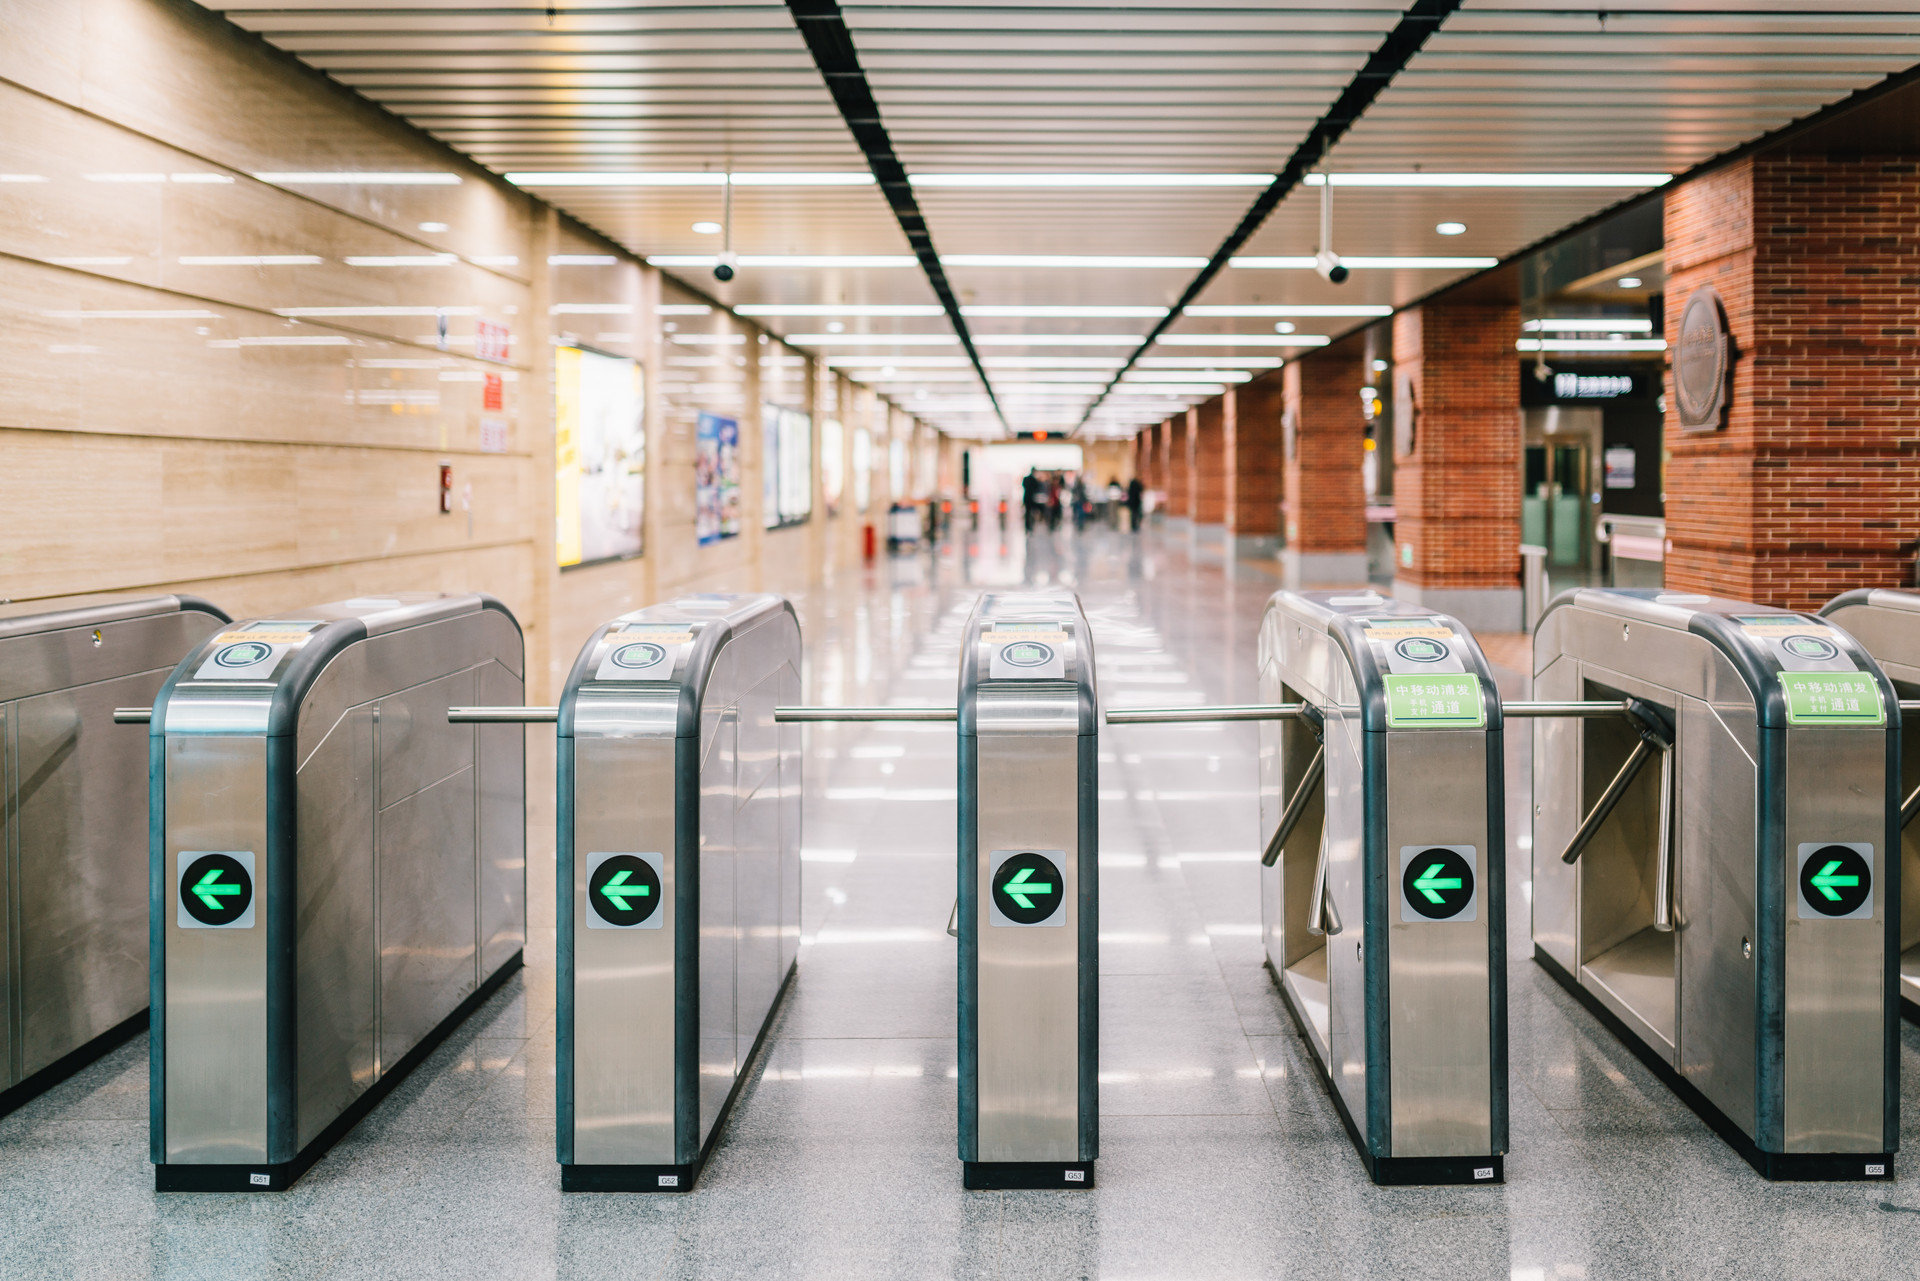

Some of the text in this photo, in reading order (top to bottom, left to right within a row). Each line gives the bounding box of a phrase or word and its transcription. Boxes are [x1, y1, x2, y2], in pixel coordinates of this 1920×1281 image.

[1395, 684, 1471, 696] 中移动浦发
[1793, 681, 1868, 694] 中移动浦发
[1431, 700, 1461, 714] 通道
[1831, 697, 1861, 712] 通道
